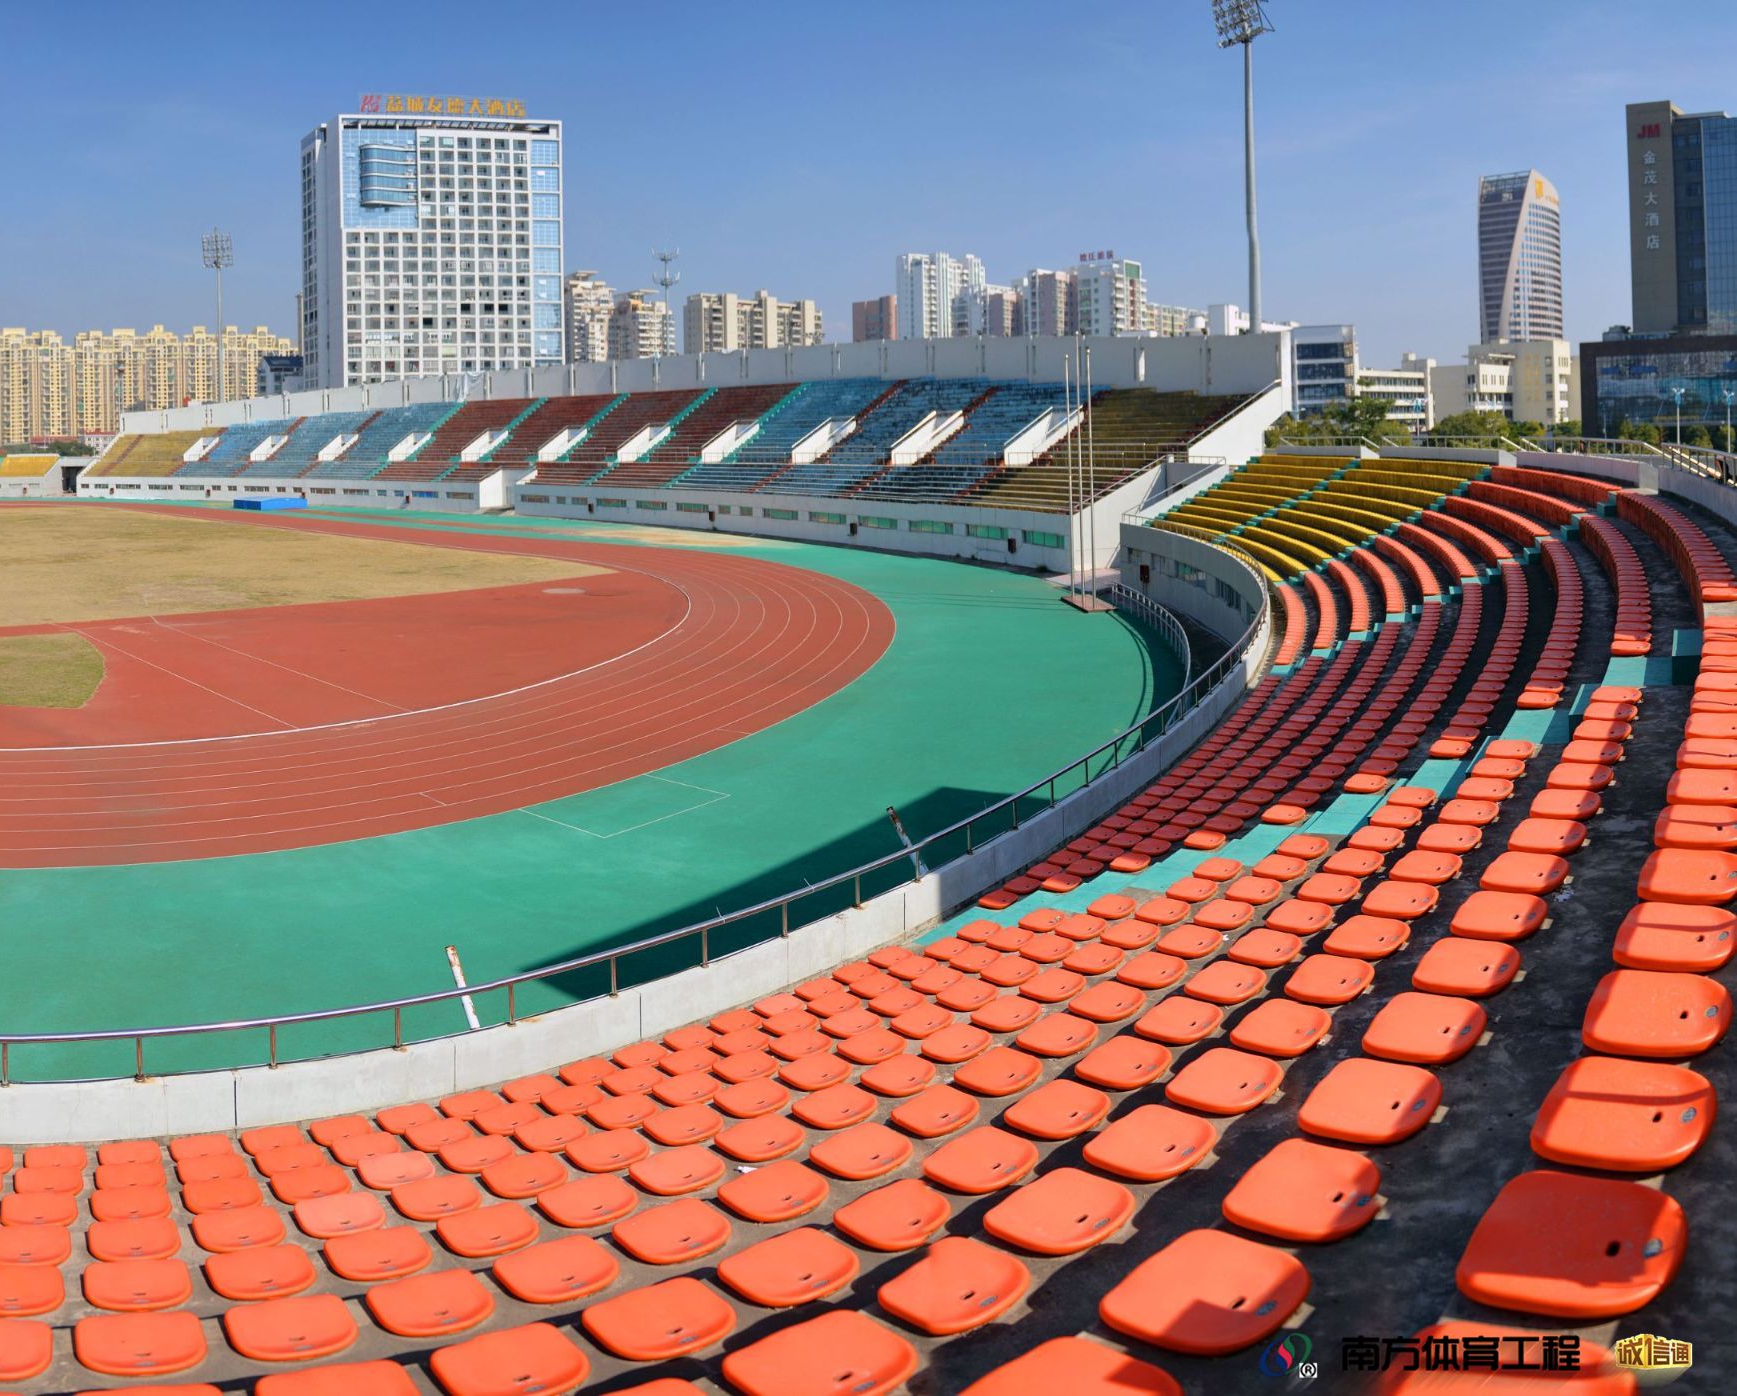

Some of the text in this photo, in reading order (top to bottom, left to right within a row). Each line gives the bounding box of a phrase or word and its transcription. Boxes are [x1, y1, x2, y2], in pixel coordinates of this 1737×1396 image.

[1637, 123, 1661, 139] JM
[1643, 150, 1660, 249] 金茂大酒店
